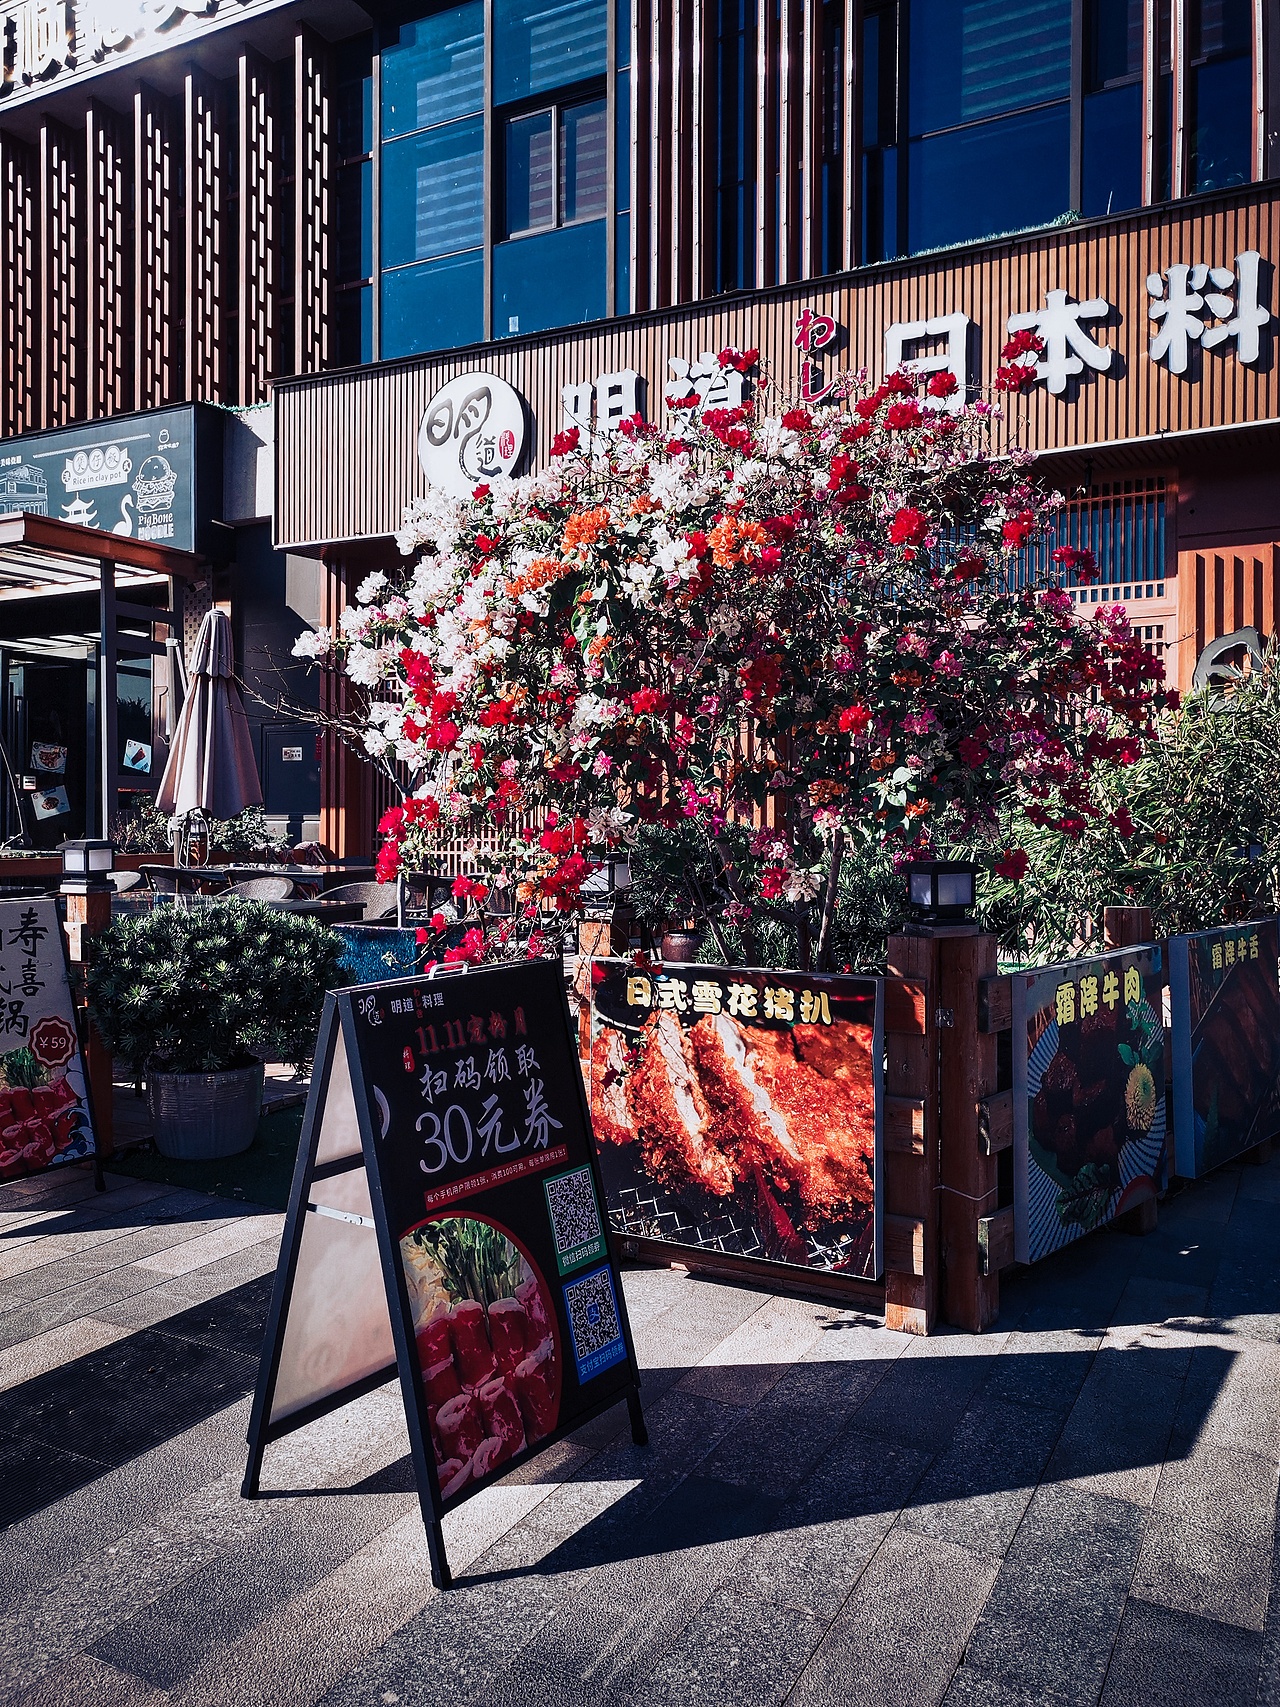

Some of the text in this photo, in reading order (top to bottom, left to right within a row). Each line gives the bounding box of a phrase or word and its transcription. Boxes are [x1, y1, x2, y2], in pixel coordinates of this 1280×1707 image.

[72, 471, 122, 486] Rice in clay pot
[137, 523, 174, 540] NOODLE
[626, 975, 834, 1025] 日式雪花猪扒
[1055, 966, 1142, 1026] 霜降牛肉
[418, 1043, 542, 1105] 扫码领取
[415, 1077, 564, 1174] 30元券
[561, 1241, 601, 1267] 微信扫码领券
[579, 1341, 625, 1376] 支付宝扫码领券
